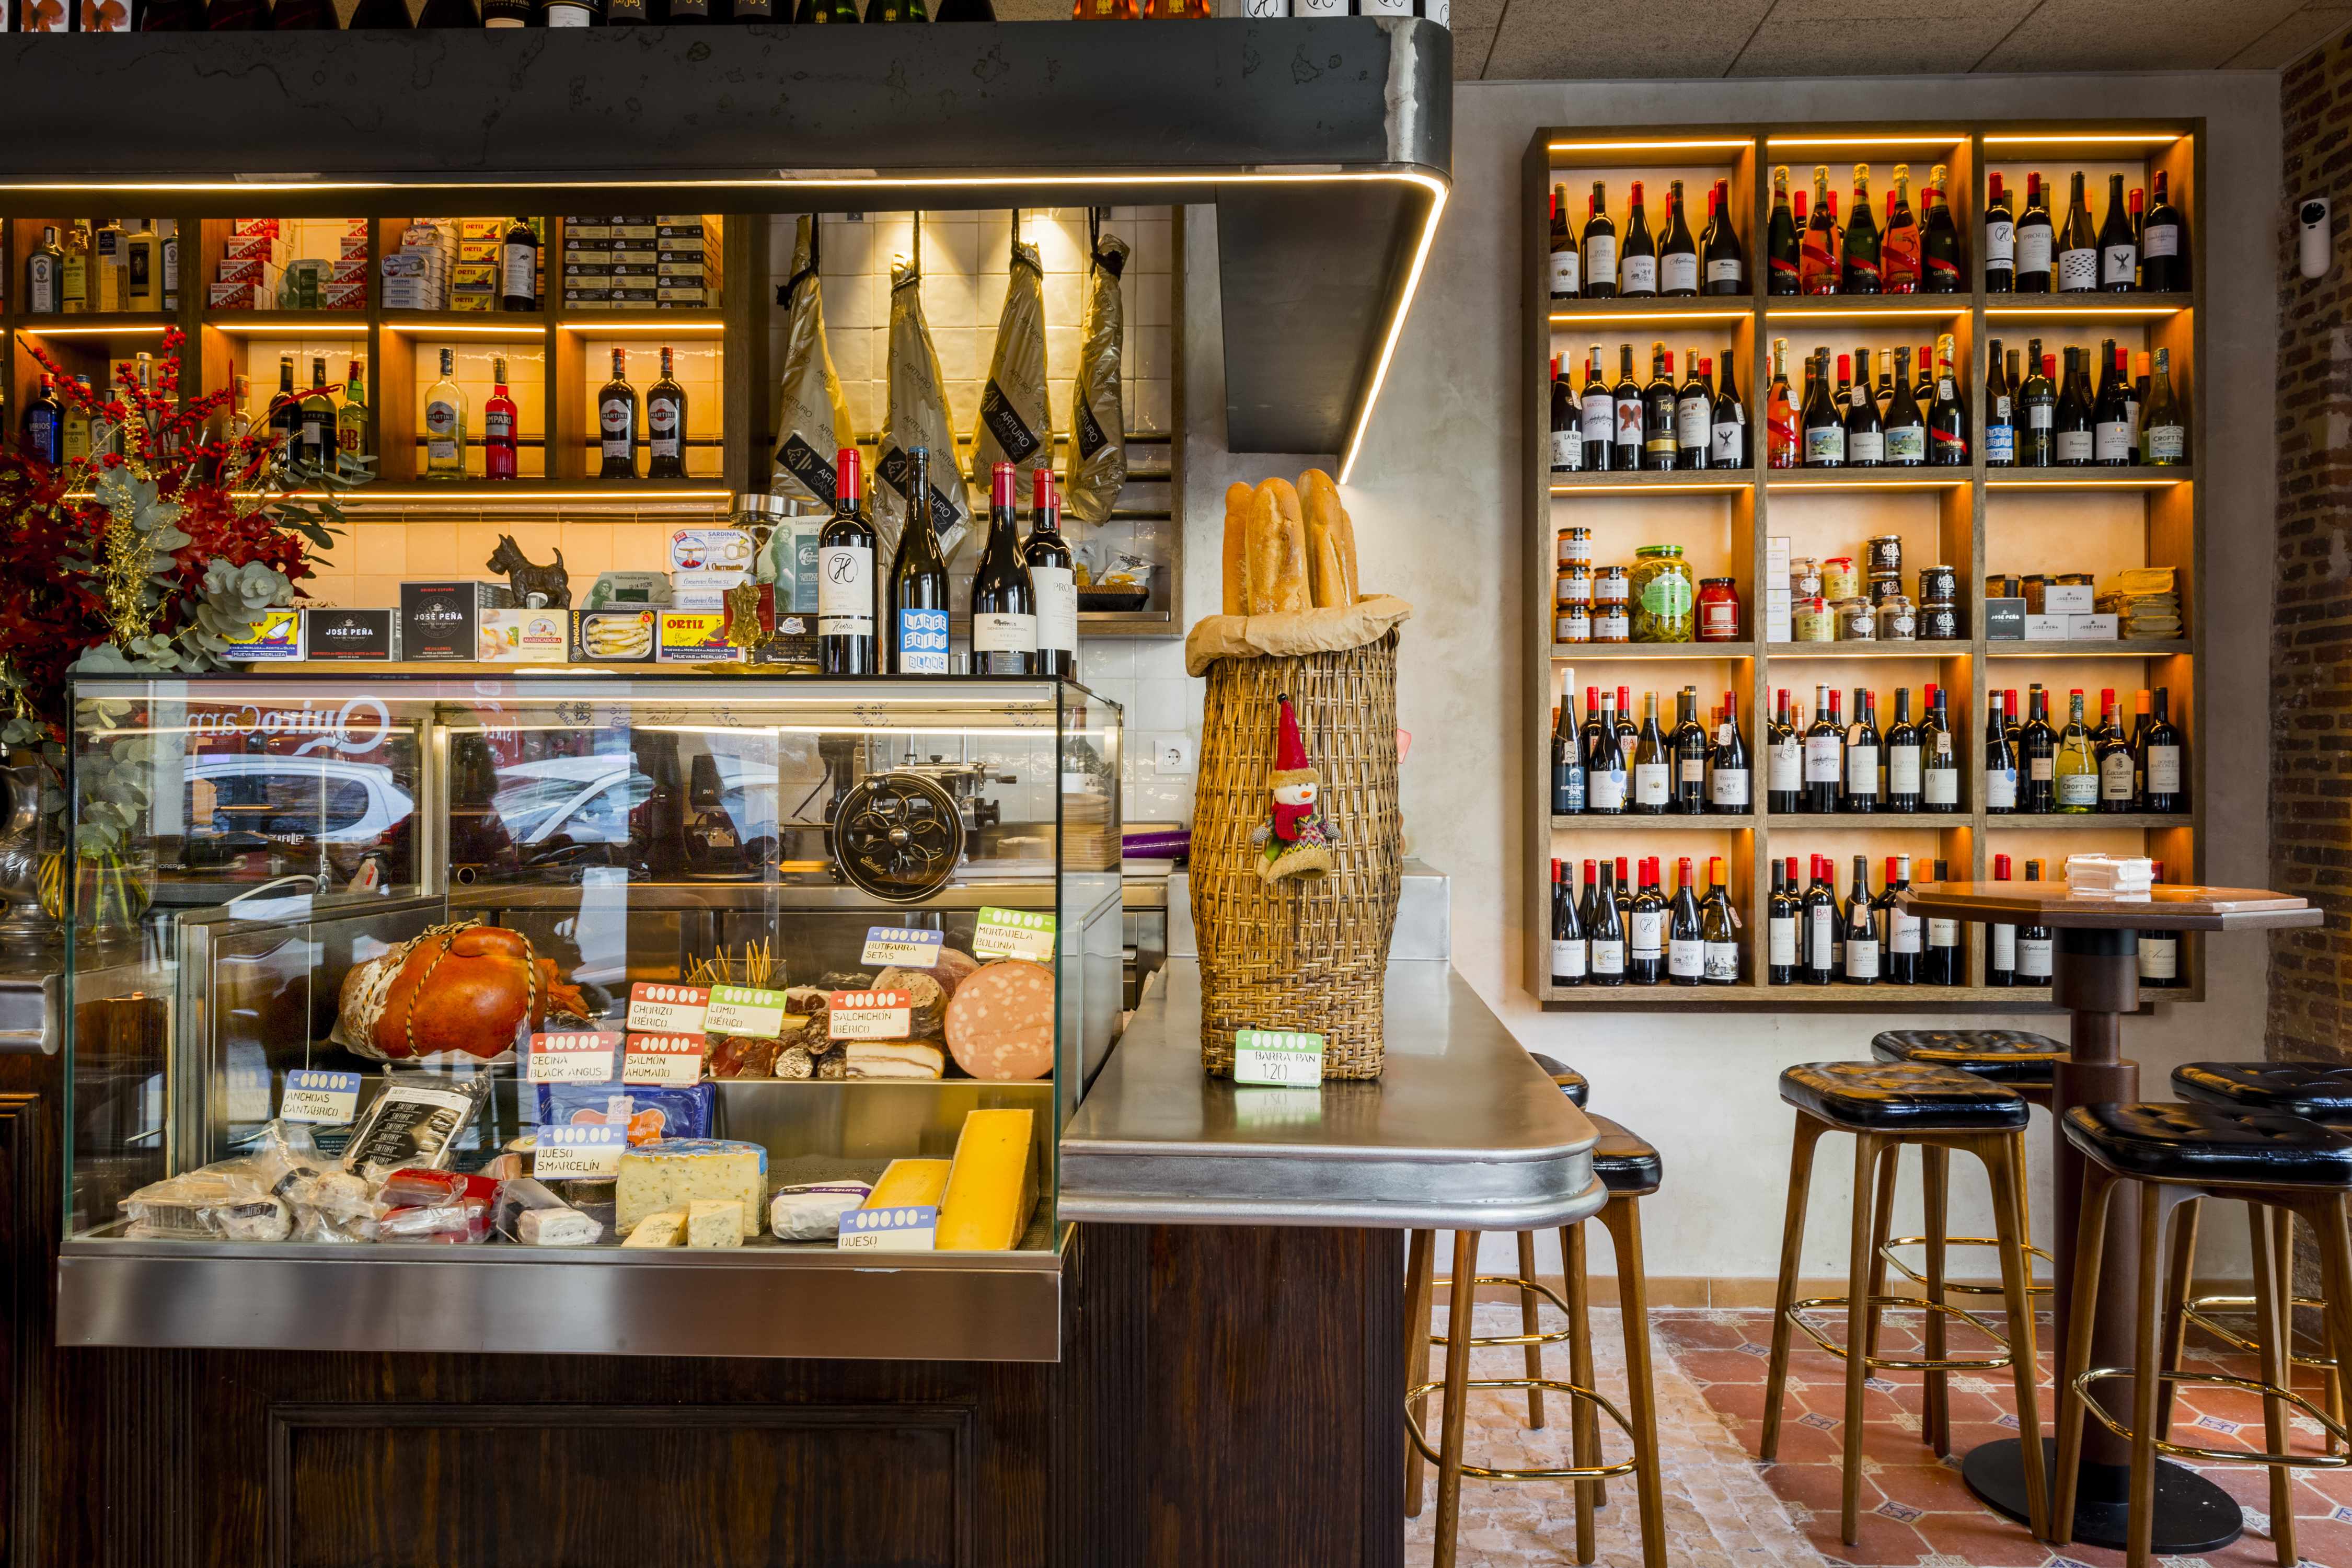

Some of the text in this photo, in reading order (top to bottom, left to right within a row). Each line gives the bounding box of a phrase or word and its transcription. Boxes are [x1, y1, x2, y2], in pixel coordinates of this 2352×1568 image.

[236, 242, 260, 259] GUAU
[348, 246, 367, 260] GUA
[228, 266, 253, 282] GUAU
[219, 289, 244, 306] GUAU
[335, 289, 360, 306] GUAU
[904, 362, 932, 390] ARTURO
[1009, 368, 1032, 395] ARTURO
[486, 416, 511, 424] AMPARI
[903, 415, 930, 443] ARTURO
[1000, 411, 1029, 447] ARTURO
[929, 492, 950, 518] TURO
[414, 612, 463, 620] JOSÉ PEÑA
[667, 619, 704, 629] ORTIZ
[906, 614, 946, 631] LARGE
[906, 633, 946, 649] SOIF!
[909, 656, 944, 670] BLANC
[978, 926, 1033, 941] MORTADELA
[868, 942, 916, 952] BUTIFARRA
[975, 938, 1016, 950] BOLONIA
[866, 951, 894, 960] SETAS
[633, 1004, 673, 1016] CHORIZO
[710, 1005, 736, 1016] LOMO
[833, 1009, 892, 1021] SALCHICHÓN
[631, 1014, 667, 1028] IBÉRICO
[708, 1016, 743, 1028] IBÉRICO
[833, 1023, 870, 1035] IBÉRICO
[532, 1056, 568, 1065] CECINA
[628, 1054, 665, 1065] SALMÓN
[1255, 1051, 1316, 1063] BARRA PAN
[531, 1067, 602, 1078] BLACK ANGUS
[625, 1067, 670, 1078] AHUMADO
[1262, 1063, 1287, 1080] 1,20
[286, 1092, 330, 1103] ANCHOAS
[283, 1103, 339, 1117] CANTÁBRICO
[538, 1148, 573, 1158] QUESO
